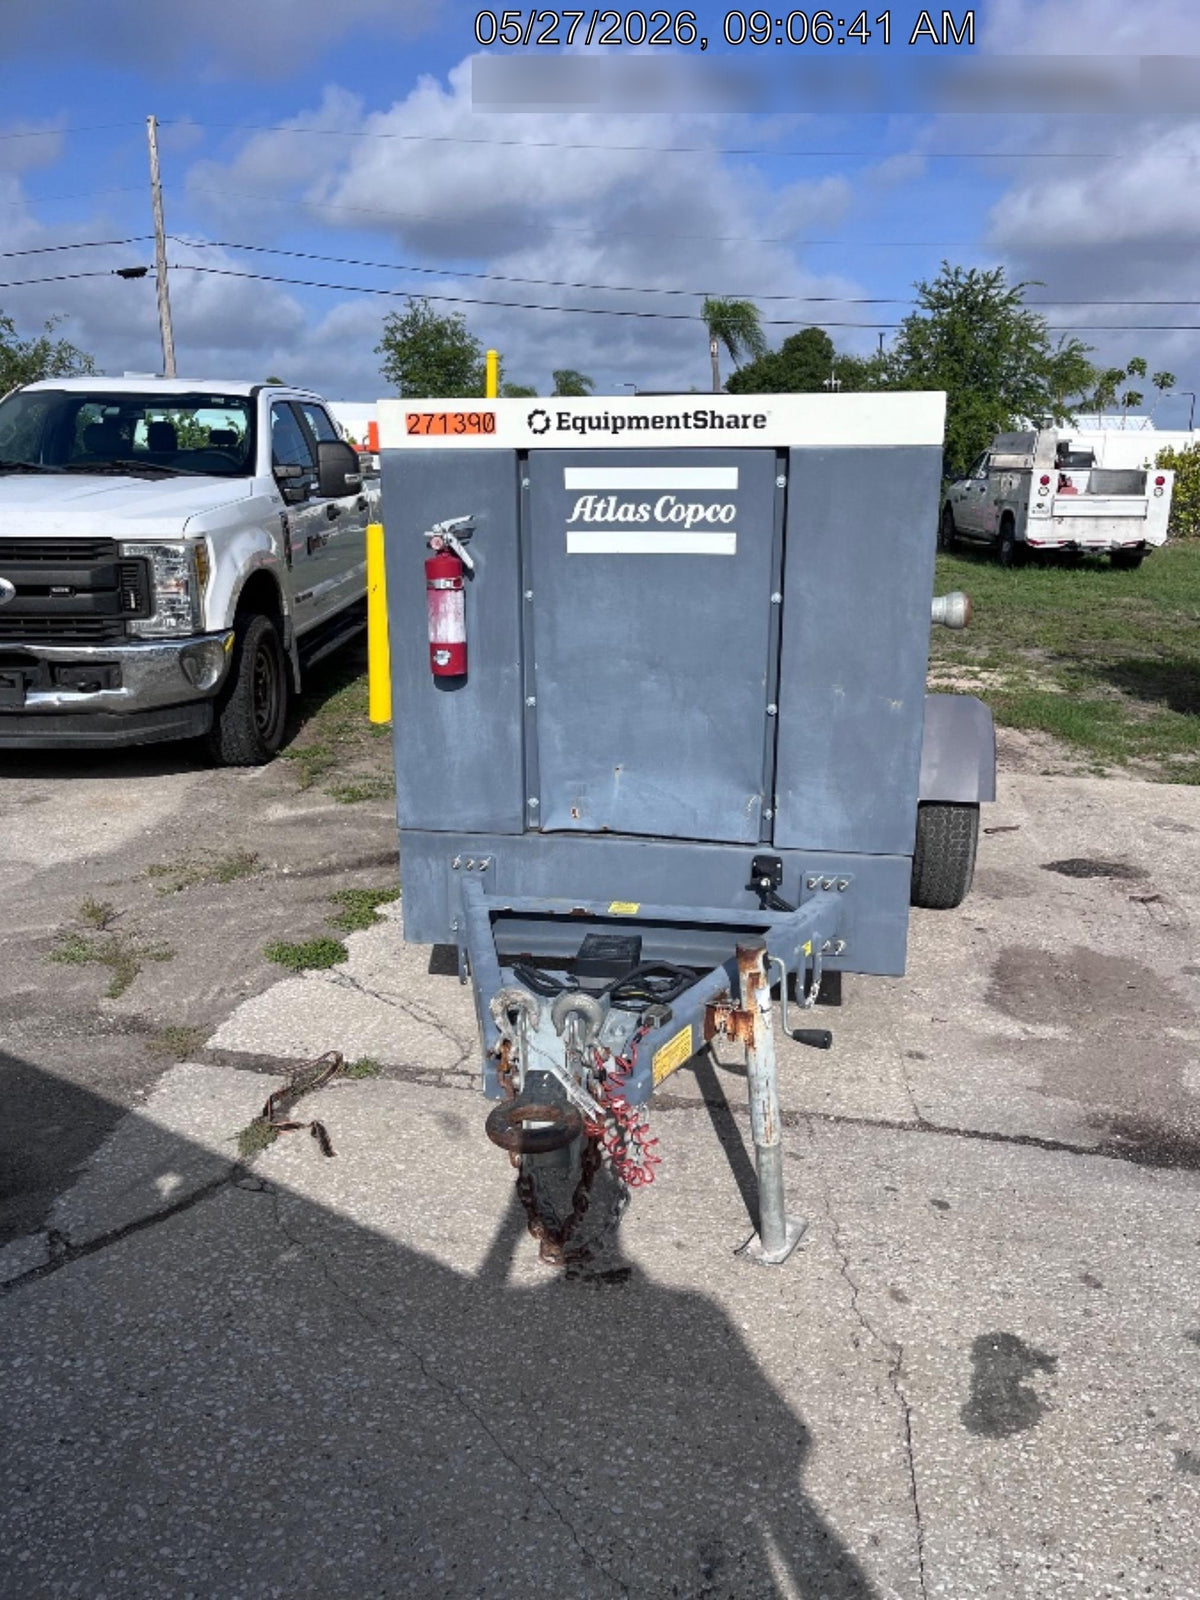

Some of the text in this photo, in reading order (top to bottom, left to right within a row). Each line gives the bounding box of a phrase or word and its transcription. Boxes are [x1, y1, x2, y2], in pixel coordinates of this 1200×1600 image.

[407, 413, 496, 434] 271390
[557, 410, 767, 434] EquipmentShare
[566, 496, 737, 528] Atlas Copco
